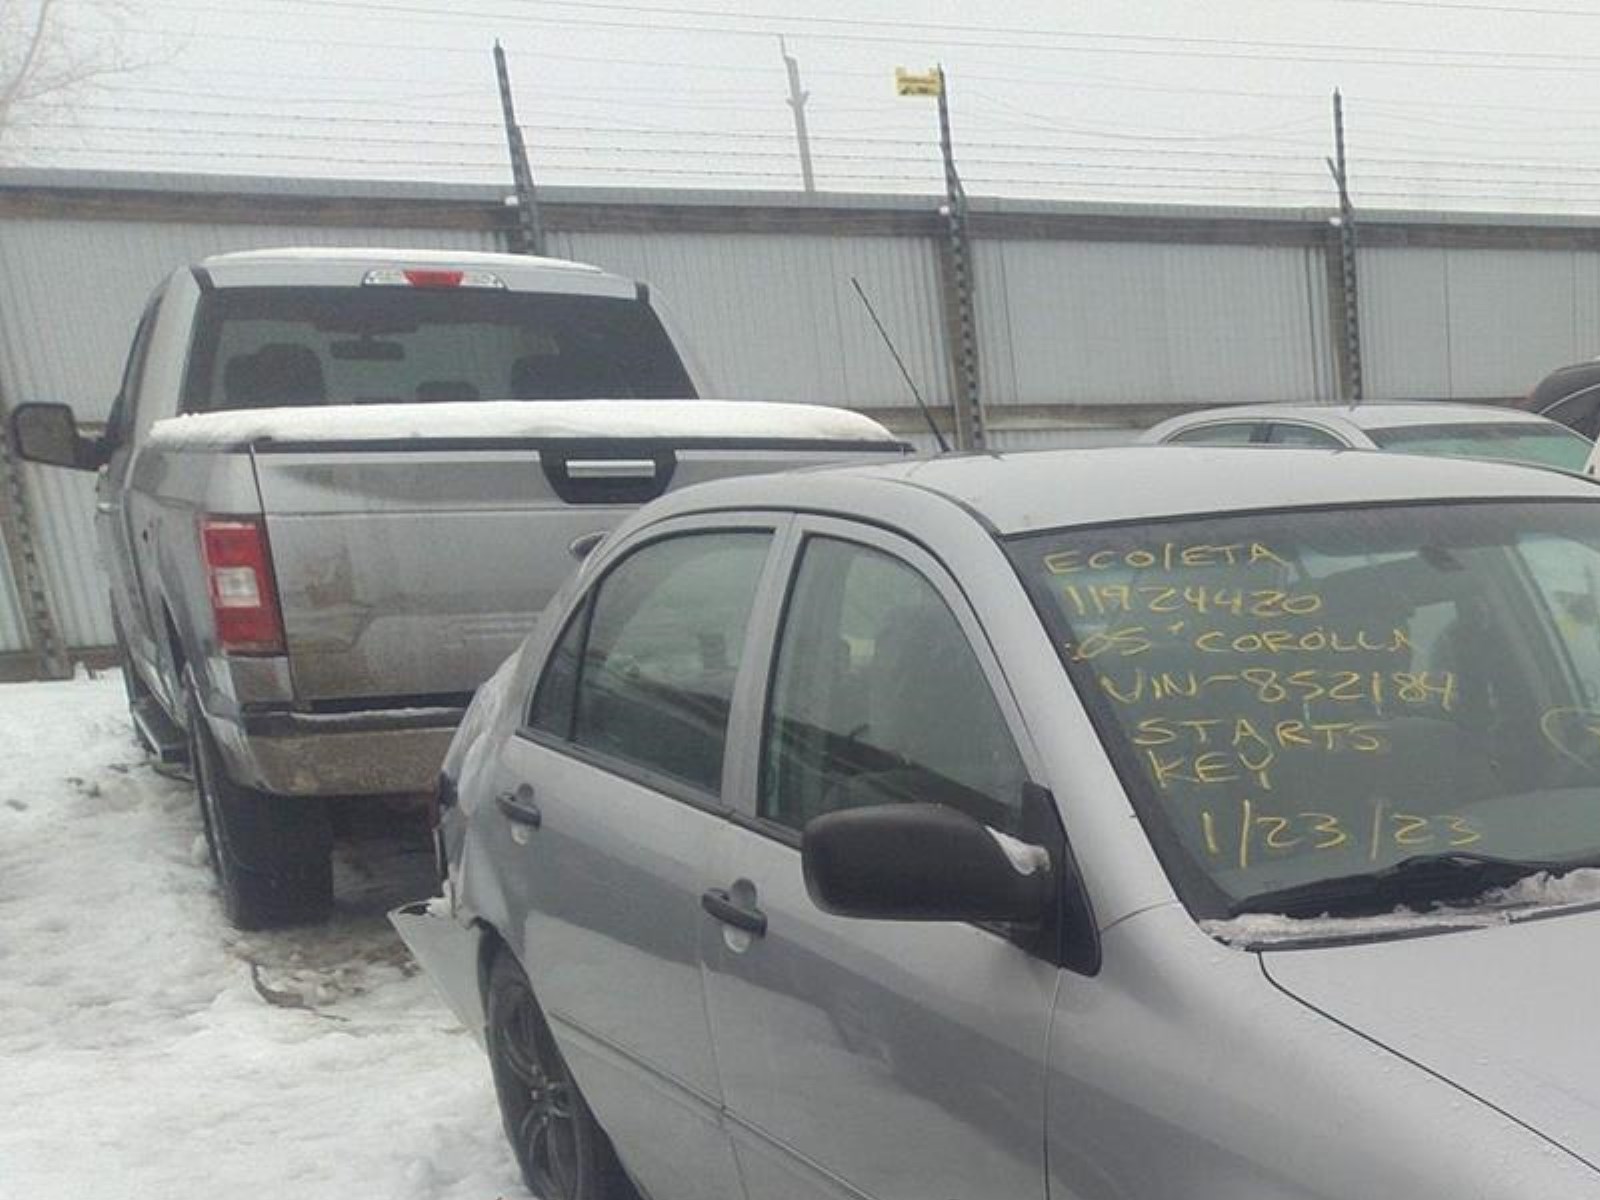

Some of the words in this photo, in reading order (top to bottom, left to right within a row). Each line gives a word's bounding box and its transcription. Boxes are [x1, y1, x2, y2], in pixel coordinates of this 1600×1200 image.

[1066, 584, 1322, 618] 11924420
[1195, 628, 1411, 653] COROLLA
[1134, 718, 1382, 752] STARTS
[1148, 749, 1276, 790] KEY
[1203, 799, 1482, 870] 1/23/23
